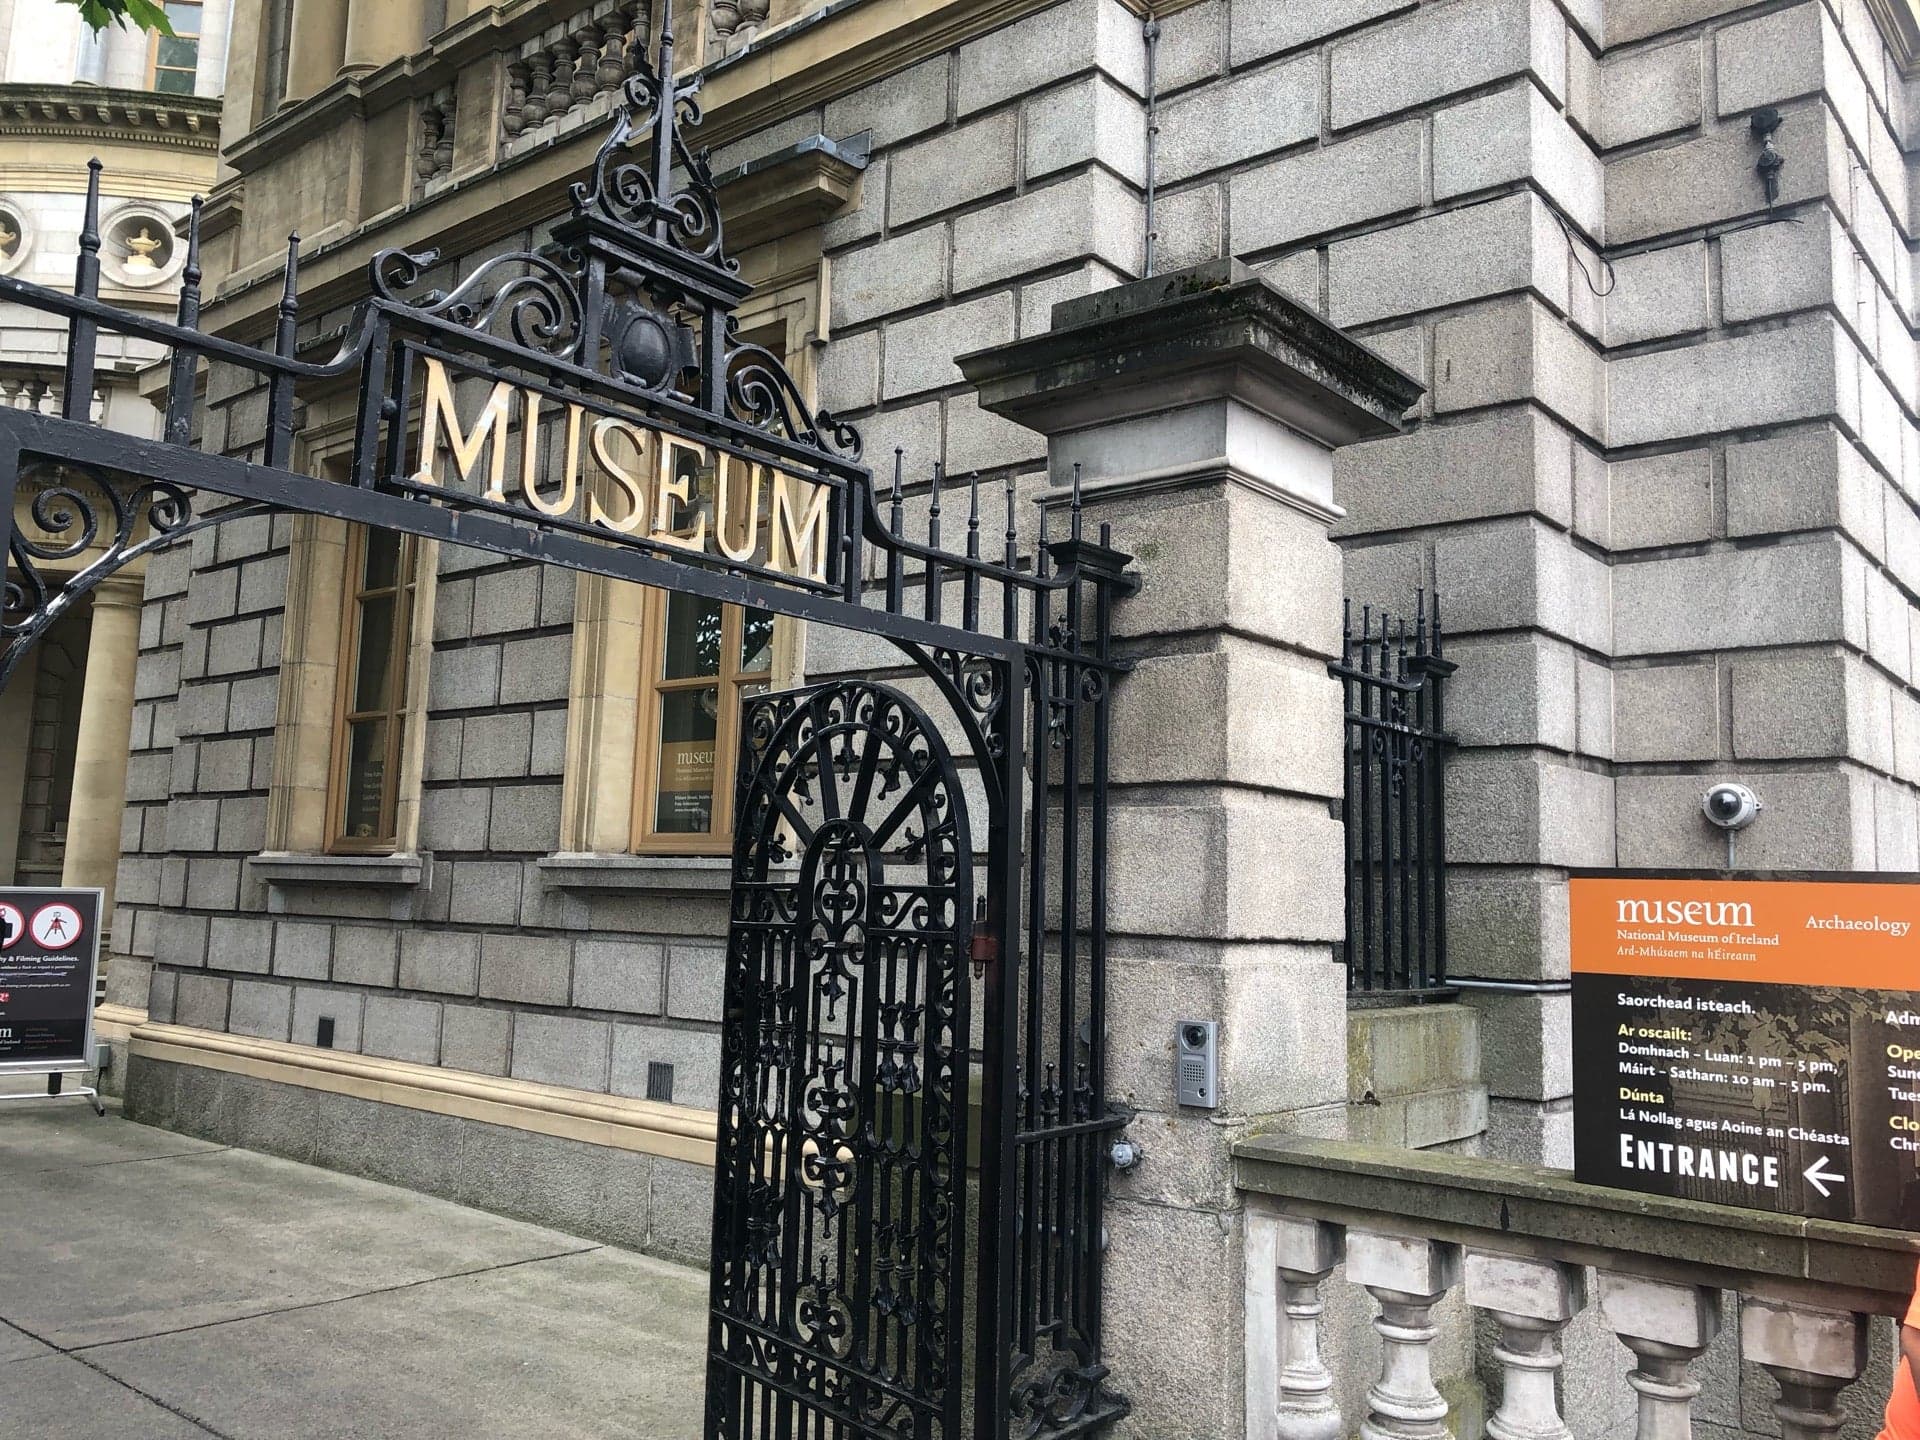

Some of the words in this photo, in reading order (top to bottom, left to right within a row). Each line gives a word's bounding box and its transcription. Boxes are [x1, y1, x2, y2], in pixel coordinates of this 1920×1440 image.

[410, 356, 831, 584] MUSEUM
[1616, 899, 1755, 927] museum
[1805, 915, 1912, 937] Archaeology
[1616, 929, 1665, 942] National
[1668, 931, 1718, 943] Museum
[1721, 932, 1736, 944] of
[1736, 934, 1780, 946] Ireland
[16, 955, 41, 963] Filming
[1616, 945, 1688, 959] Ard-Mhúsaem
[1691, 951, 1704, 960] na
[1707, 947, 1757, 962] hÉireann
[1617, 993, 1692, 1010] Saorchead
[1696, 997, 1756, 1014] isteach.
[1618, 1023, 1635, 1037] Ar
[1638, 1026, 1692, 1041] oscailt:
[1618, 1042, 1689, 1059] Domhnach
[1705, 1049, 1743, 1064] Luan:
[1747, 1055, 1755, 1065] 1
[1759, 1056, 1781, 1069] pm
[1798, 1060, 1805, 1073] 5
[1809, 1060, 1838, 1075] pm,
[1619, 1061, 1655, 1076] Máirt
[1670, 1066, 1728, 1083] Satharn:
[1732, 1075, 1749, 1085] 10
[1753, 1077, 1775, 1088] am
[1791, 1081, 1798, 1093] 5
[1803, 1081, 1831, 1094] pm.
[1619, 1087, 1665, 1104] Dúnta
[1620, 1108, 1635, 1121] Lá
[1639, 1110, 1683, 1129] Nollag
[1686, 1118, 1718, 1132] agus
[1721, 1120, 1762, 1135] Aoine
[1766, 1127, 1784, 1138] an
[1788, 1127, 1850, 1145] Chéasta
[1620, 1133, 1779, 1188] ENTRANCE
